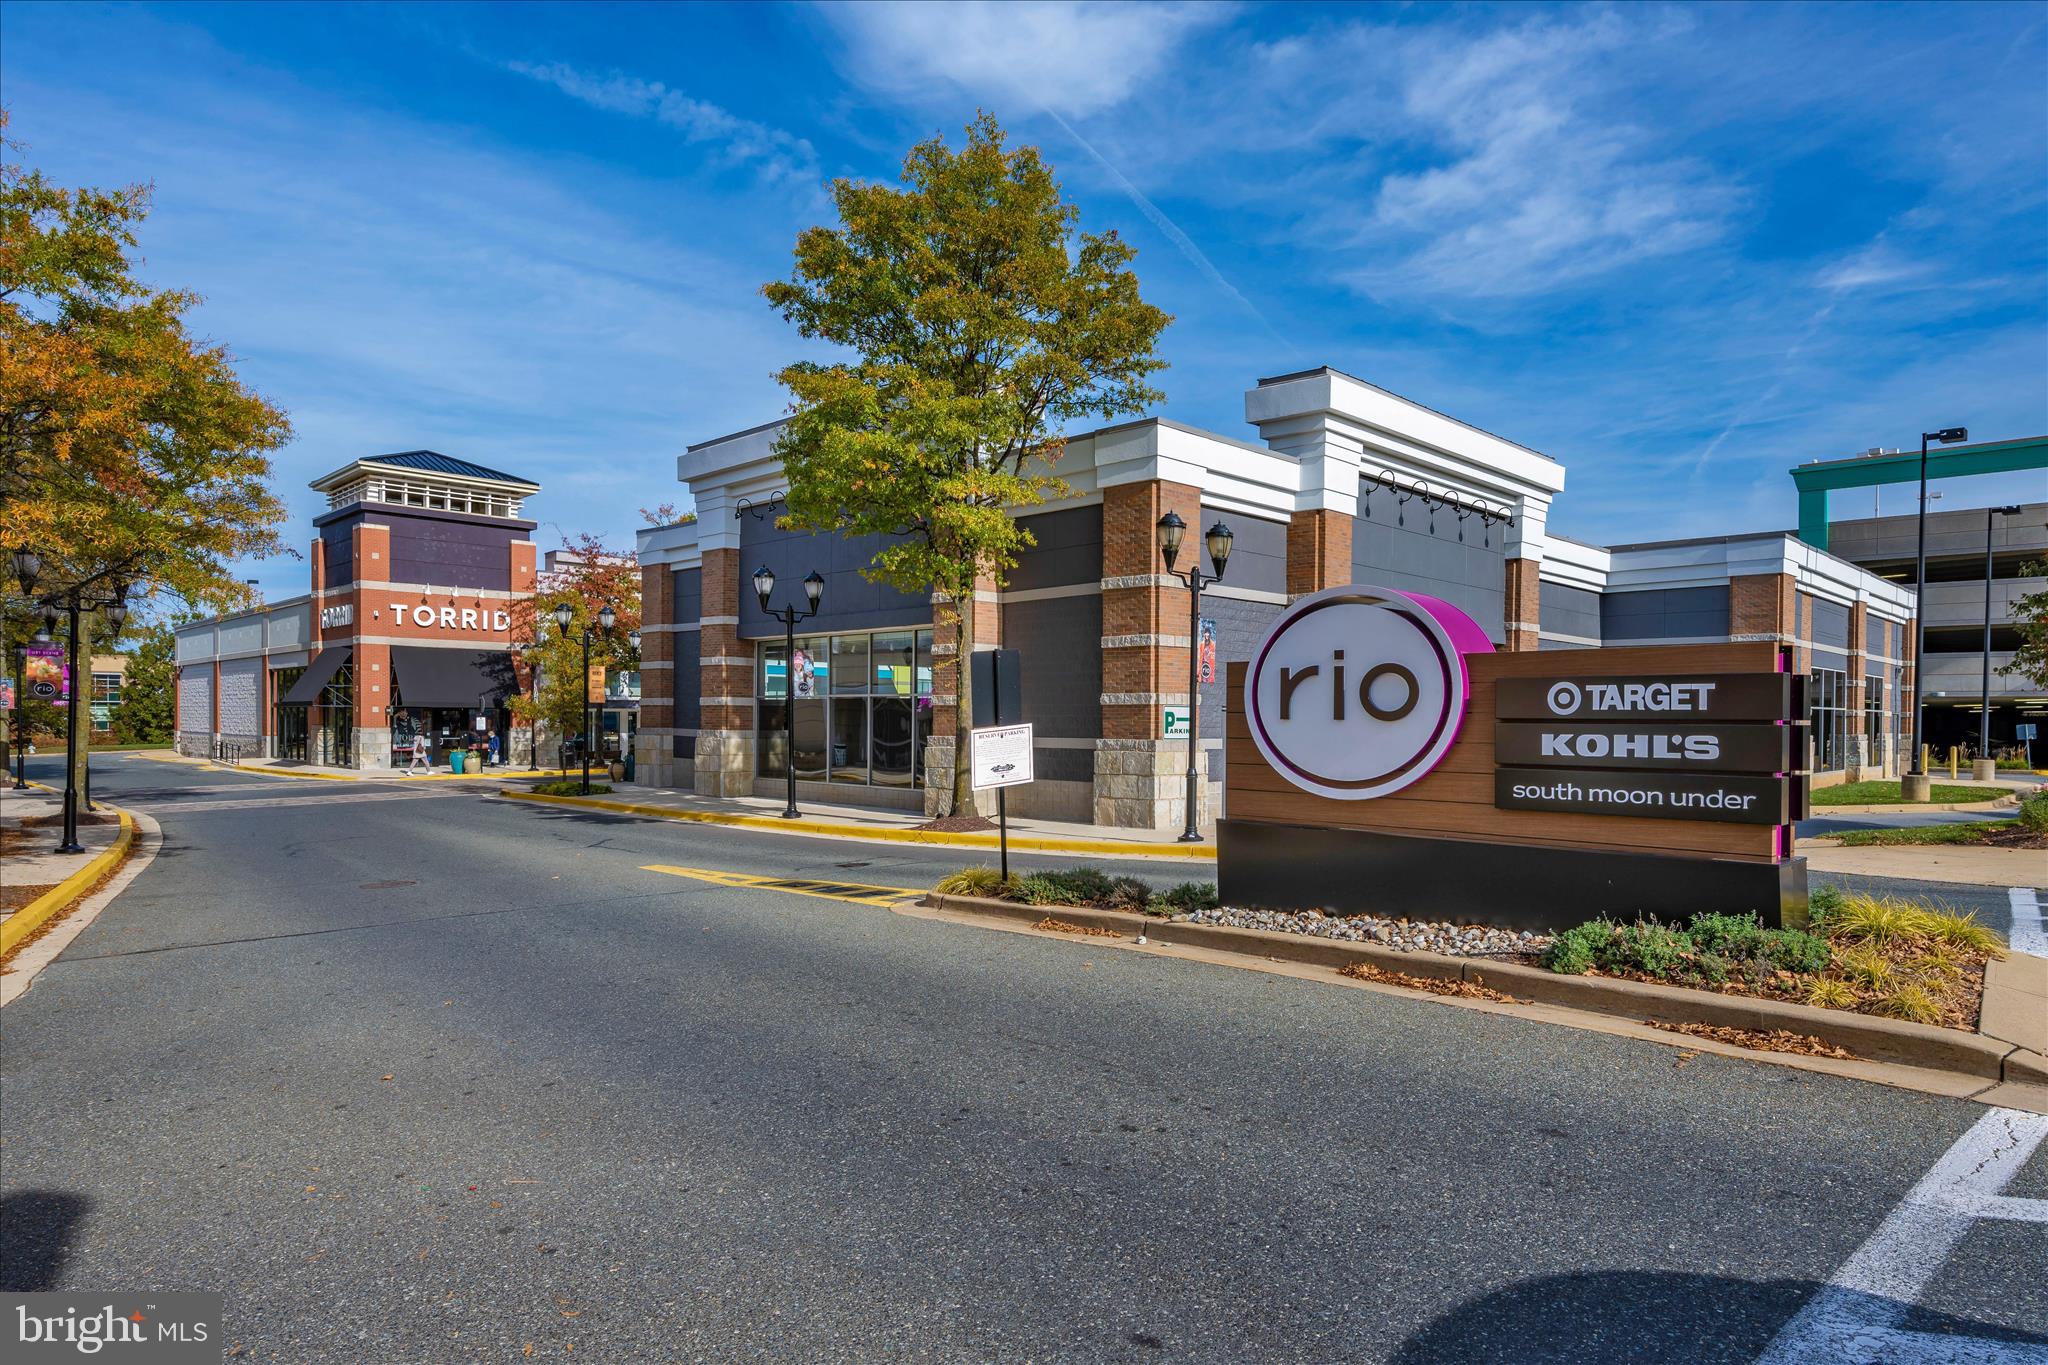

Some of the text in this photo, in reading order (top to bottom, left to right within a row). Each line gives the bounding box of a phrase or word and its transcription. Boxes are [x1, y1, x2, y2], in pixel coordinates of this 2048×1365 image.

[389, 603, 511, 632] TORRID
[1279, 649, 1420, 722] rio
[1585, 683, 1716, 711] TARGET
[1164, 711, 1190, 734] PARKIN
[1541, 733, 1720, 760] KOHL'S
[1512, 783, 1757, 810] south moon under
